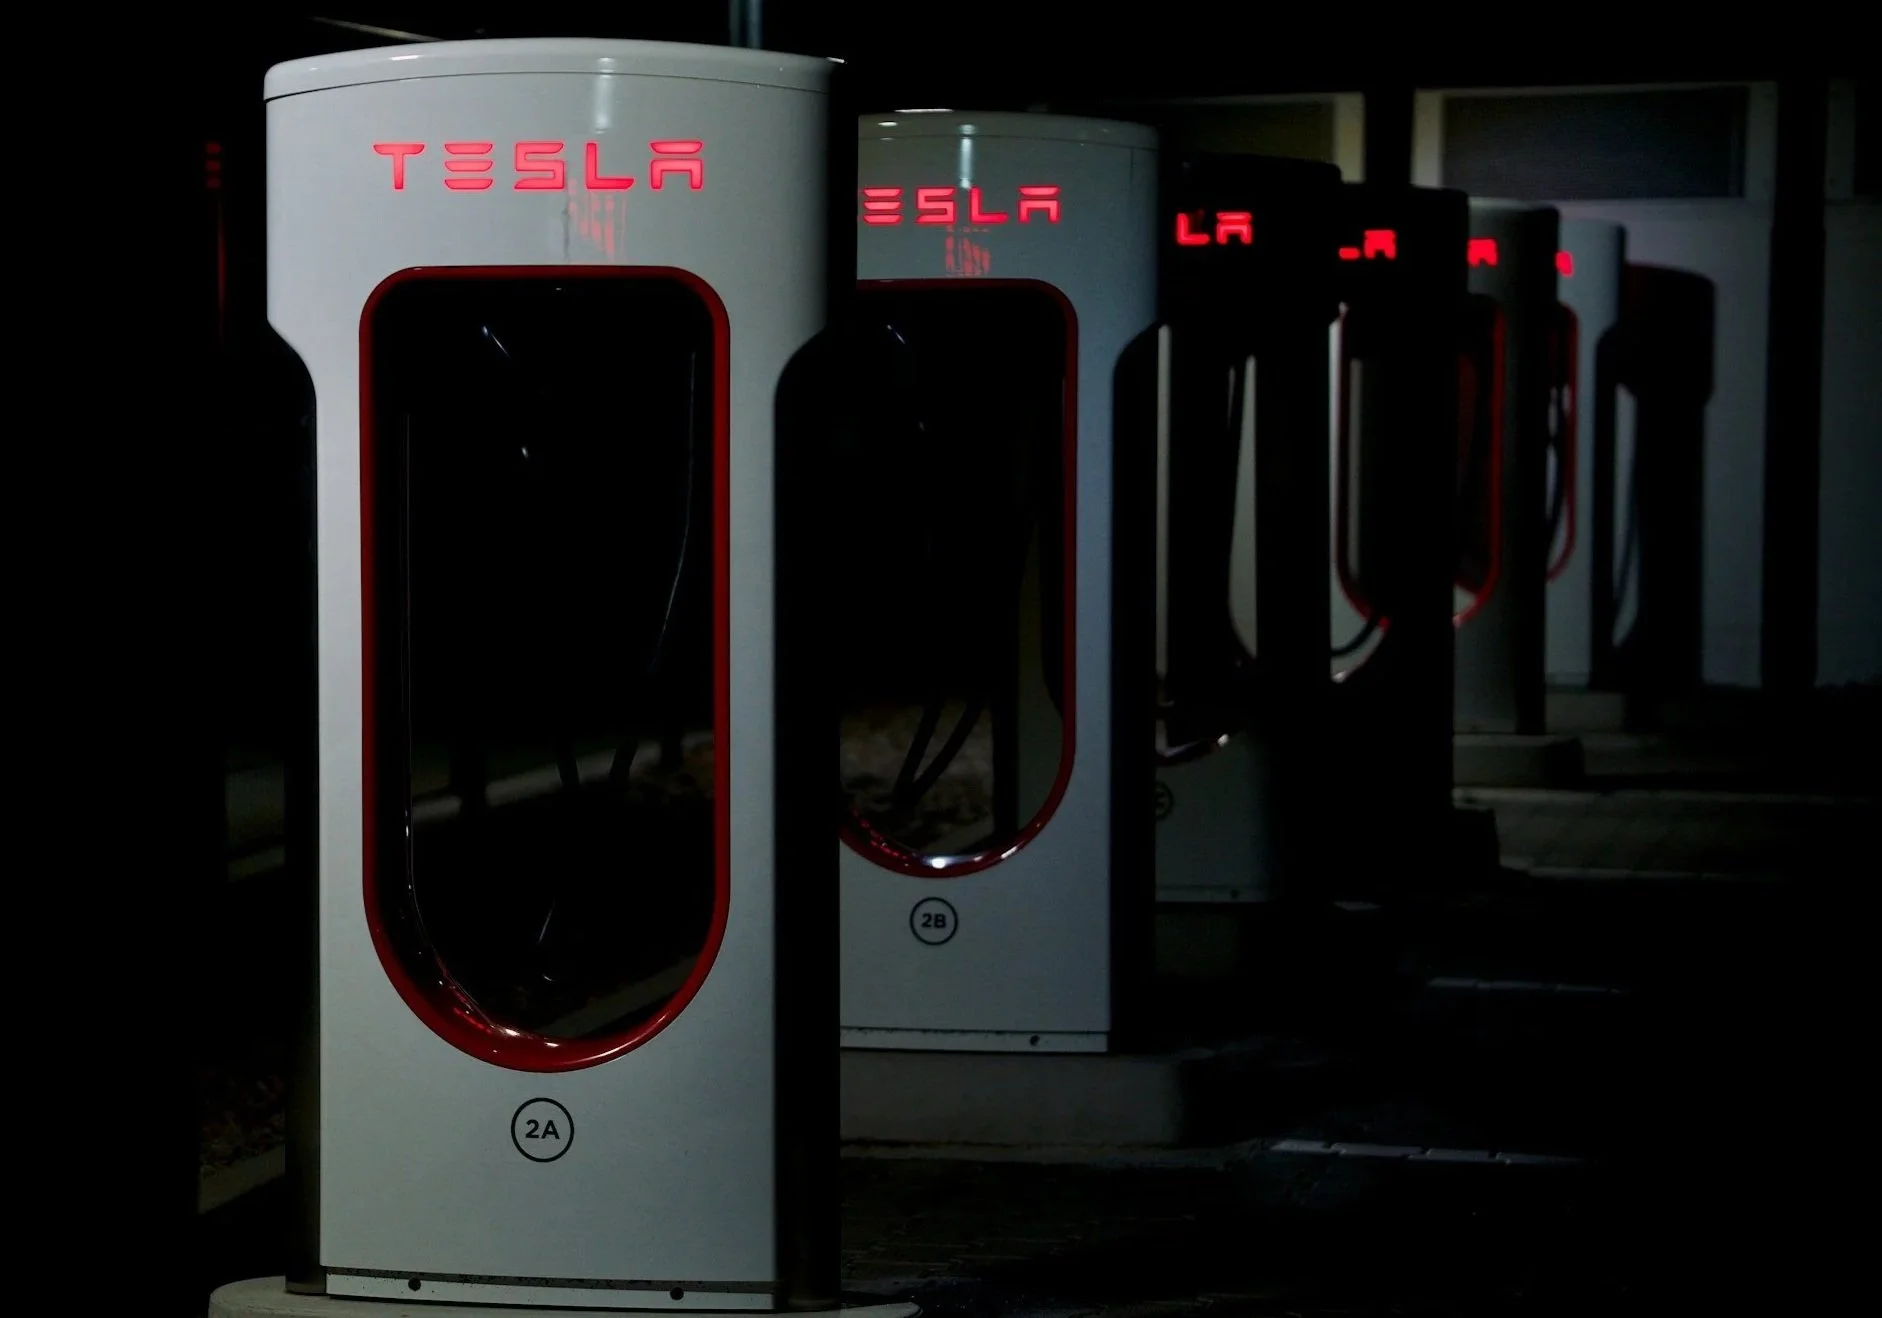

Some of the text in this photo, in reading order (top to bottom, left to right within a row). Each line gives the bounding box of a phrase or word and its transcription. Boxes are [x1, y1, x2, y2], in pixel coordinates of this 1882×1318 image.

[373, 141, 703, 190] TESLA
[921, 913, 947, 929] 2B
[526, 1119, 560, 1139] 2A
